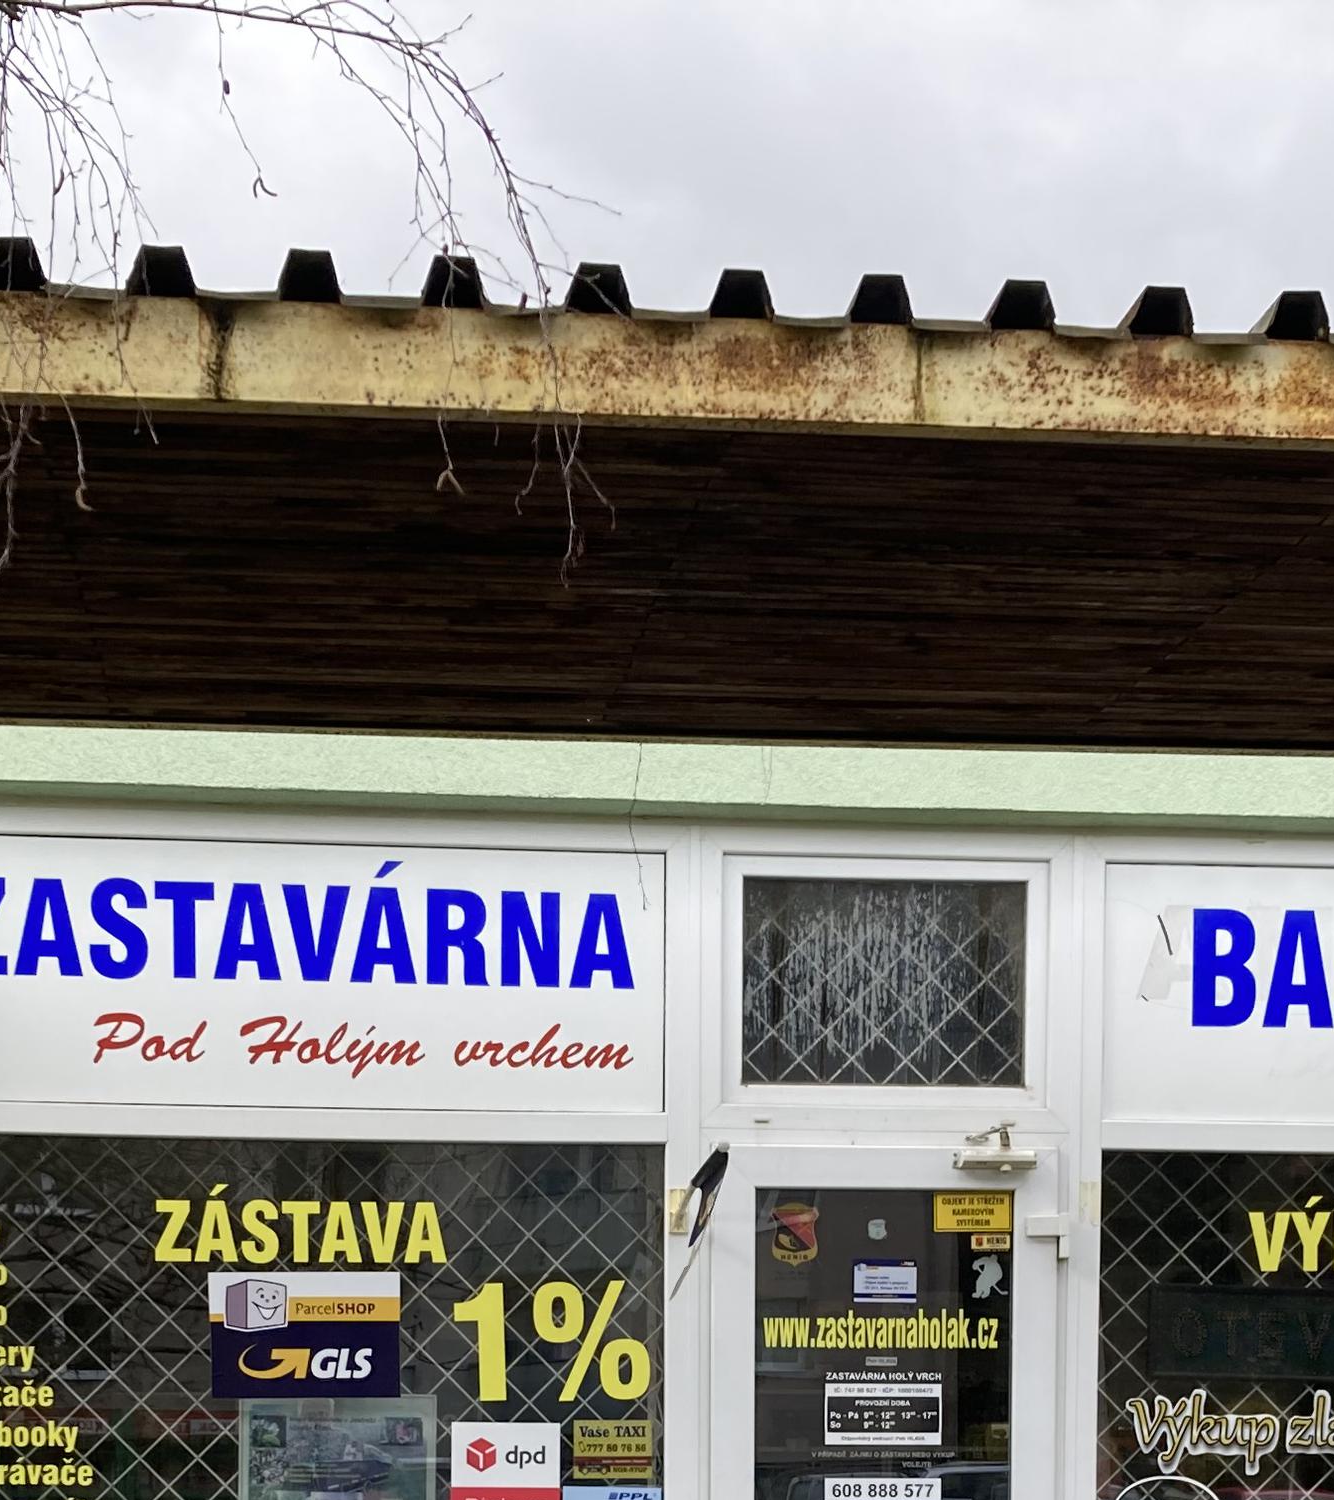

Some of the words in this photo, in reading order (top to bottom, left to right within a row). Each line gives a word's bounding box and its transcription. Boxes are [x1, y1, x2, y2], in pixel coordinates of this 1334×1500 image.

[93, 1013, 207, 1065] Pod
[240, 1015, 425, 1079] Holým
[454, 1023, 634, 1071] vrchem
[154, 1183, 448, 1264] ZÁSTAVA
[295, 1302, 376, 1316] ParcelSHOP
[763, 1308, 998, 1349] www.zastavarnaholak.cz
[454, 1280, 652, 1404] 1%
[310, 1347, 373, 1380] GLS
[825, 1370, 887, 1381] ZASTAVÁRNA
[888, 1371, 915, 1381] HOLÝ
[916, 1372, 942, 1381] VRCH
[829, 1411, 841, 1419] Po
[613, 1425, 647, 1438] TAXI
[1128, 1397, 1277, 1464] Výkup
[505, 1445, 546, 1469] dpd
[586, 1443, 604, 1453] 777
[618, 1492, 653, 1500] PPL
[832, 1484, 863, 1498] 608
[868, 1484, 898, 1498] 888
[904, 1484, 934, 1498] 577
